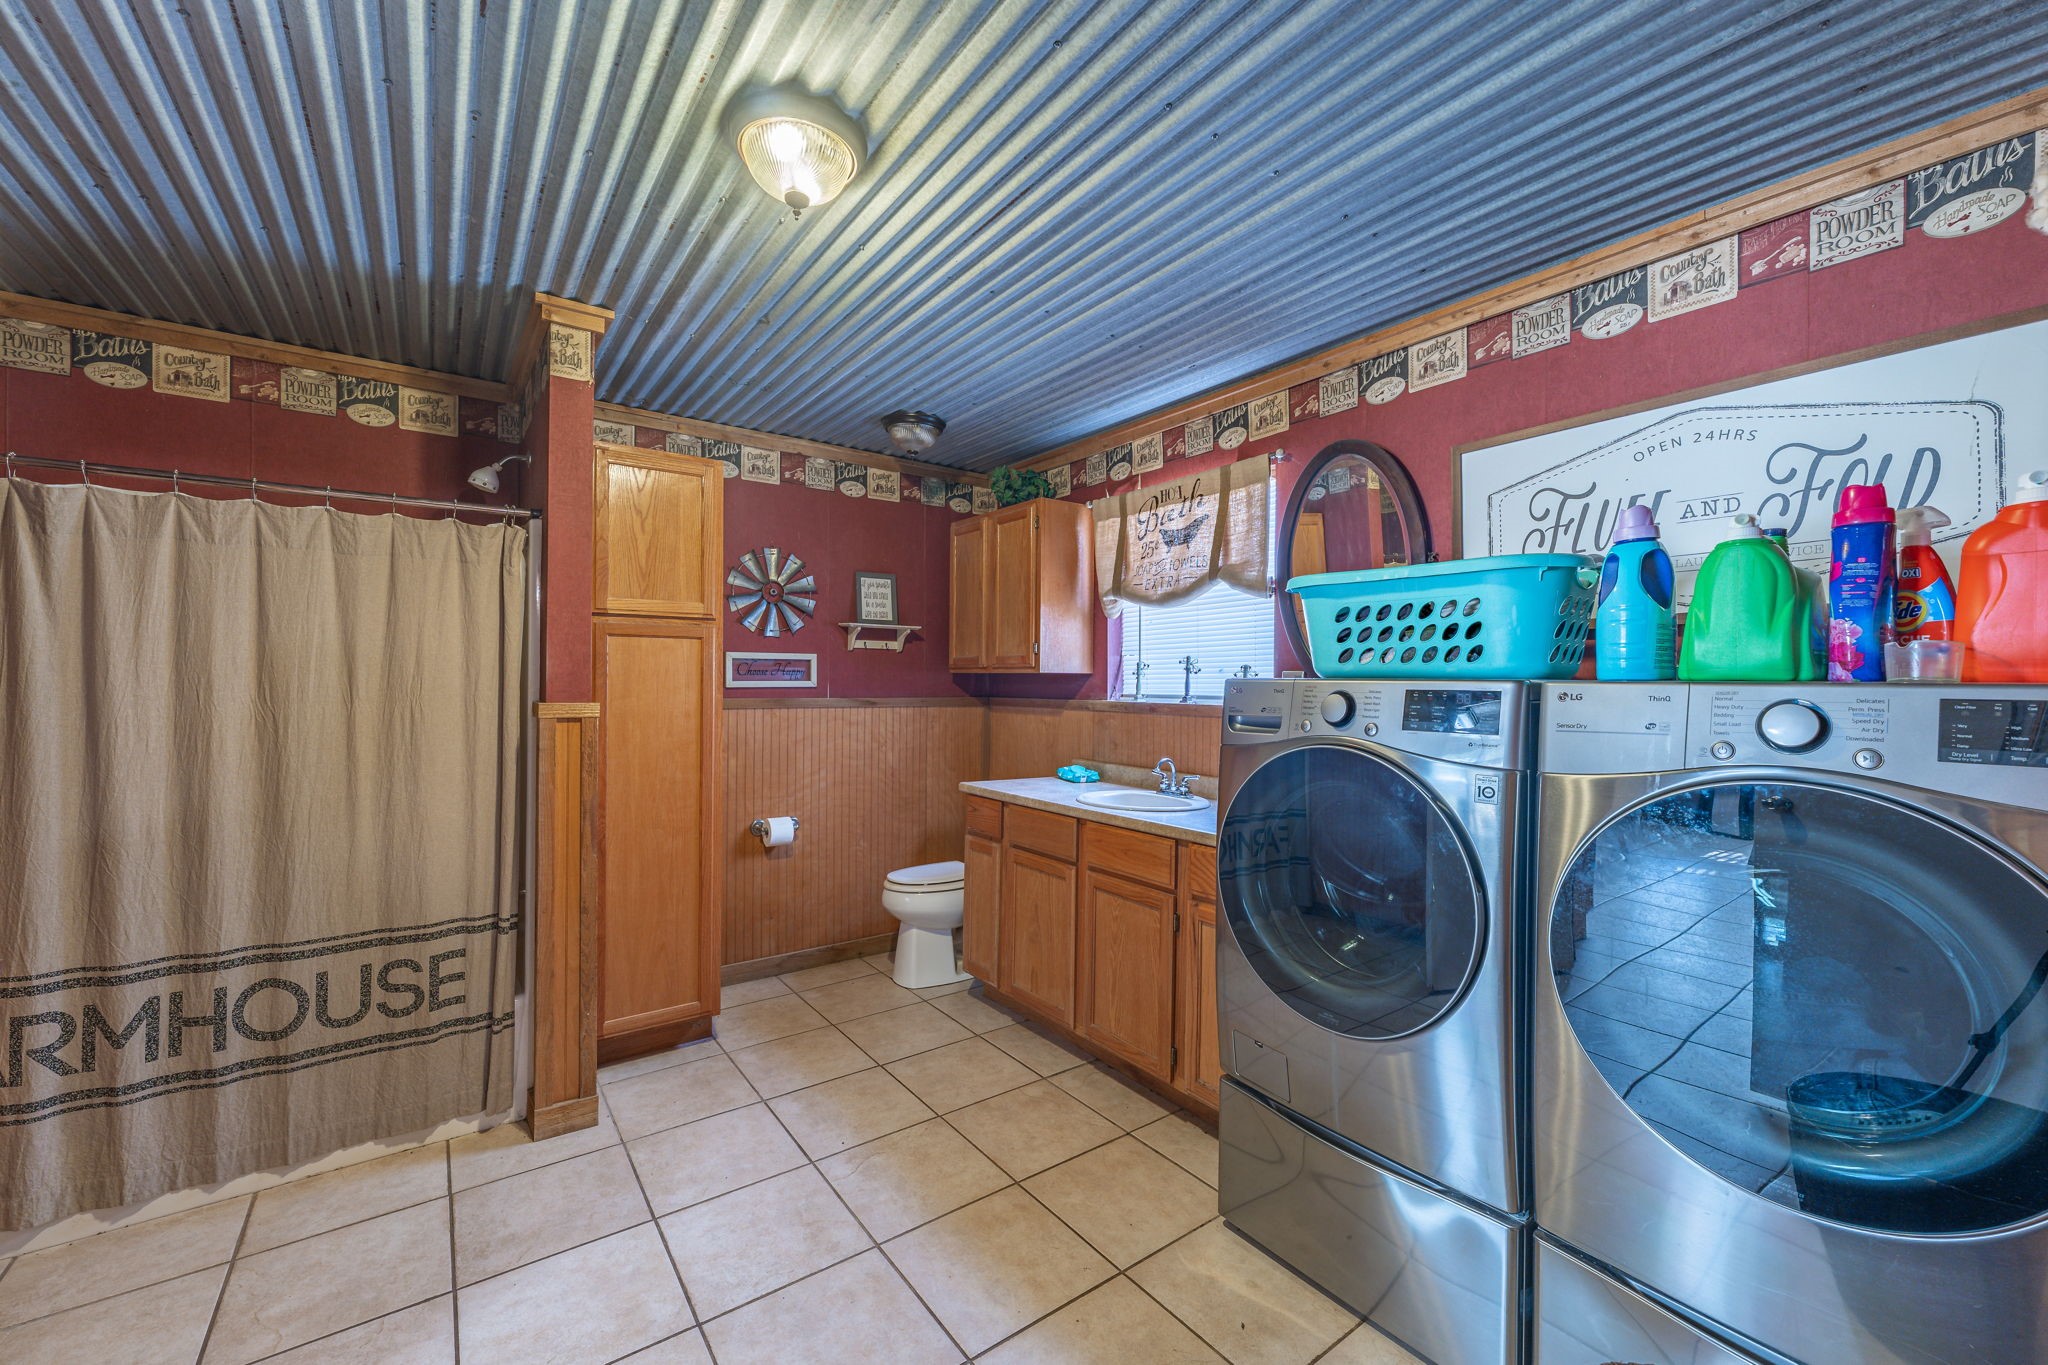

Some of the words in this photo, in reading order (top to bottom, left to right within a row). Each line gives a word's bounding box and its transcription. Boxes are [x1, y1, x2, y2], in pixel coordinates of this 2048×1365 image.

[1932, 192, 1996, 230] Handmade
[1976, 193, 2017, 218] SOAP
[1816, 199, 1896, 243] POWDER
[1817, 220, 1896, 256] ROOM
[1659, 246, 1714, 284] Country
[1691, 265, 1727, 294] Bath
[1515, 307, 1566, 338] POWDER
[1612, 308, 1638, 326] SOAP
[1, 331, 65, 356] POWDER
[1516, 323, 1566, 348] ROOM
[2, 348, 65, 365] ROOM
[559, 349, 583, 369] Bath
[1416, 336, 1451, 363] Country
[164, 352, 212, 371] Country
[1437, 350, 1460, 372] Bath
[193, 371, 221, 392] Bath
[284, 379, 332, 399] POWDER
[1321, 378, 1355, 400] POWDER
[285, 393, 332, 407] ROOM
[408, 394, 444, 409] Country
[1254, 396, 1278, 416] Country
[1322, 391, 1356, 408] ROOM
[430, 407, 452, 427] Bath
[594, 426, 622, 439] Country
[1187, 426, 1212, 443] POWDER
[1187, 437, 1212, 451] ROOM
[1633, 436, 1683, 462] OPEN
[1692, 428, 1758, 444] 24HRS
[1160, 485, 1183, 503] HOT
[1137, 478, 1206, 541] Bath
[1680, 496, 1741, 520] AND
[1169, 555, 1209, 573] TOWELS
[1901, 567, 1920, 578] OXI
[1143, 575, 1183, 592] EXTRA
[1895, 600, 1923, 620] ide
[737, 662, 768, 676] Choose
[771, 662, 807, 680] Happy
[1648, 695, 1671, 703] ThinQ
[1477, 786, 1496, 799] 10
[0, 948, 467, 1089] RMHOUSE
